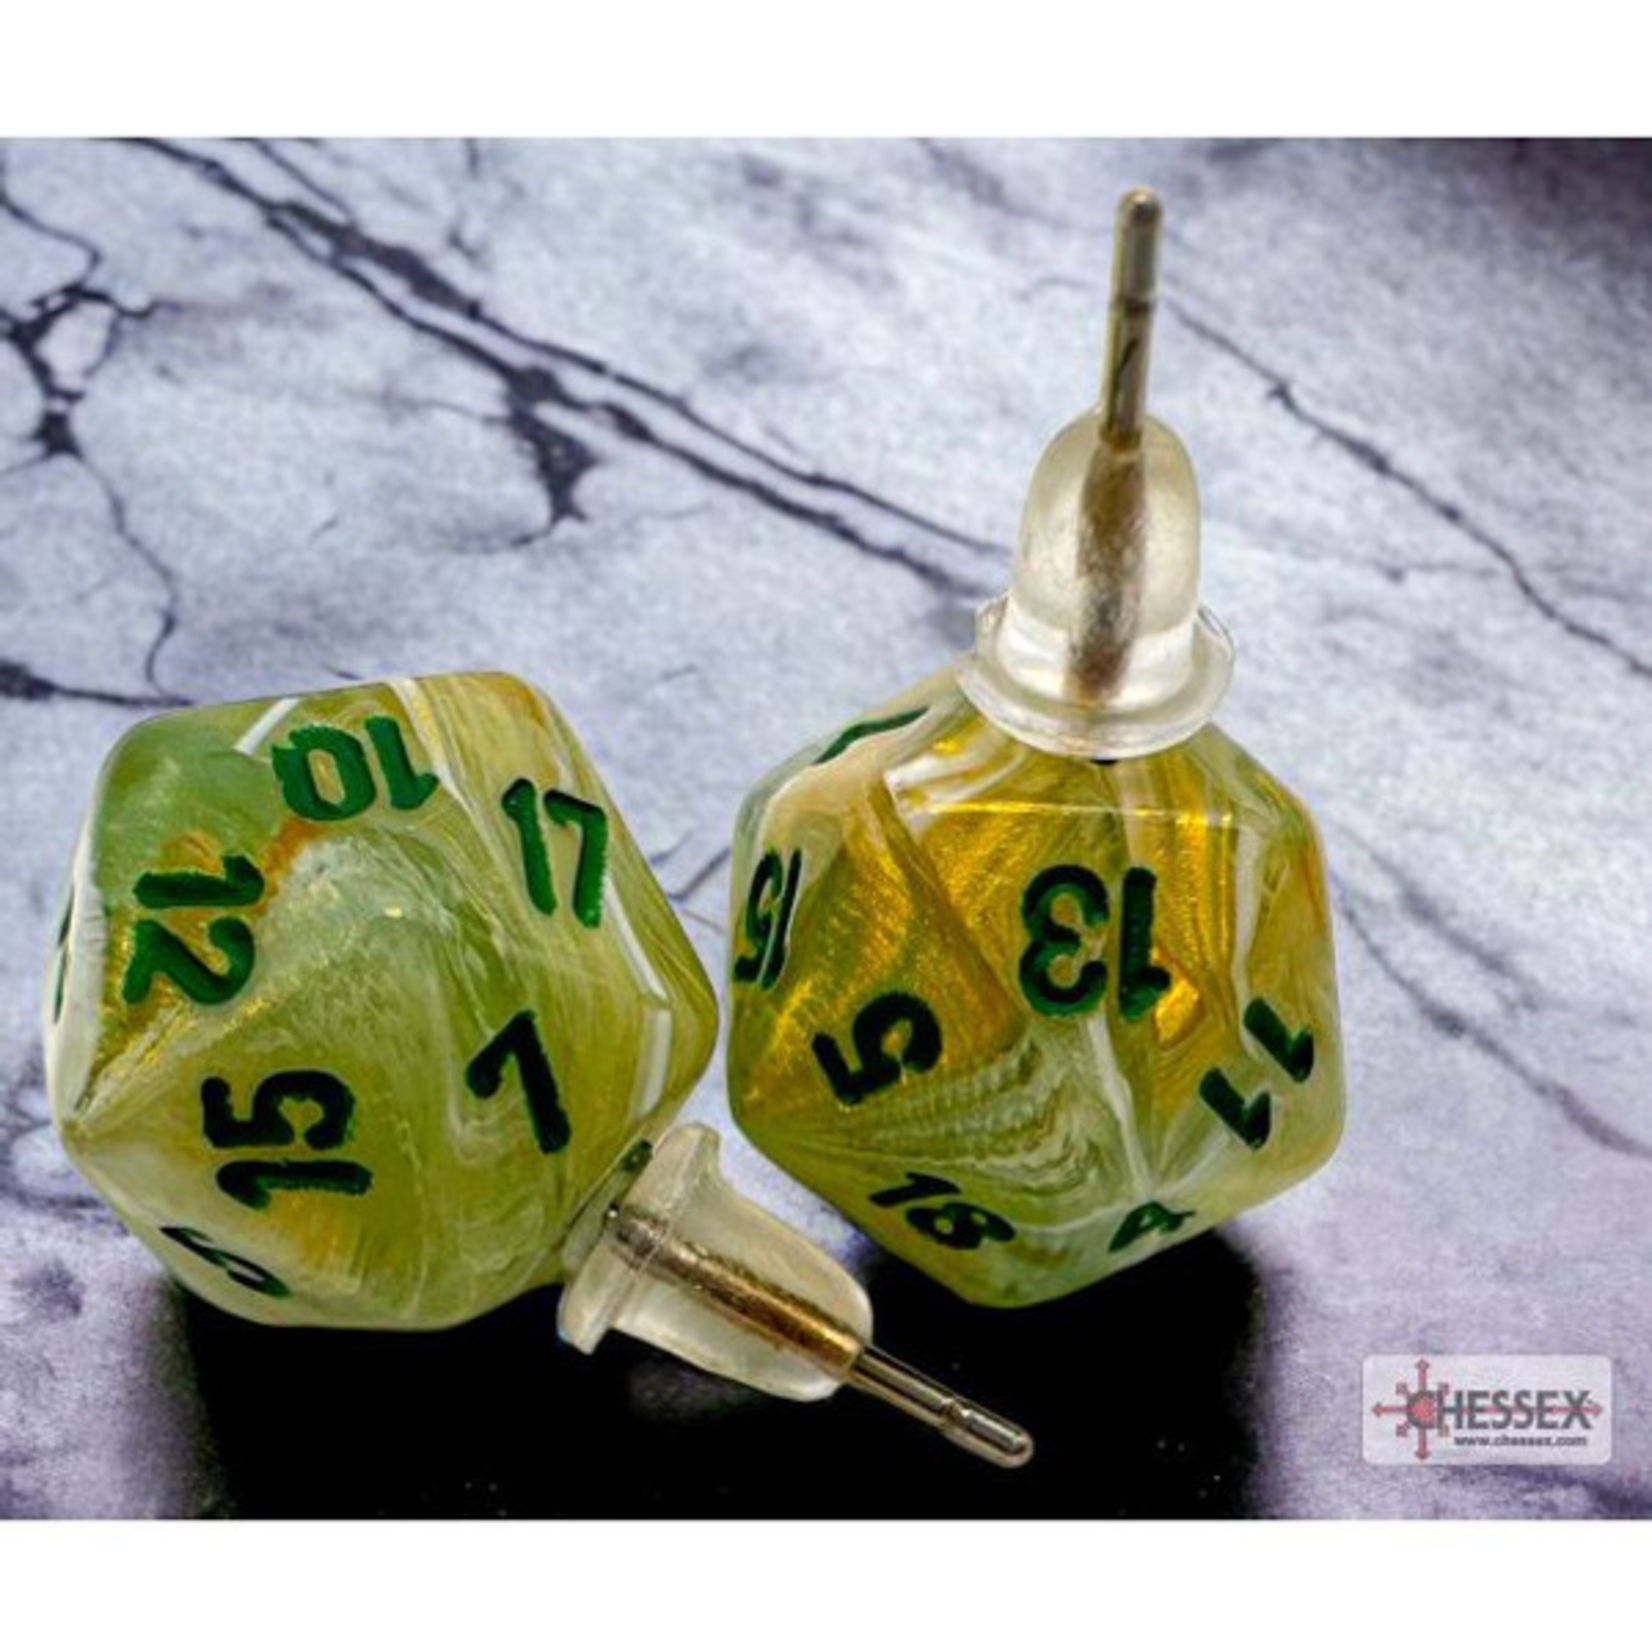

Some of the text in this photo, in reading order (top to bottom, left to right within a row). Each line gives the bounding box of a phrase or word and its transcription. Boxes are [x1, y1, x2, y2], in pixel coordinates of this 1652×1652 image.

[272, 715, 438, 821] 10
[501, 777, 608, 928] 17
[123, 854, 265, 1006] 12
[1019, 864, 1170, 1021] 13
[466, 1010, 571, 1154] 7
[811, 991, 942, 1105] 5
[201, 1069, 373, 1210] 15
[868, 1172, 1015, 1249] 18
